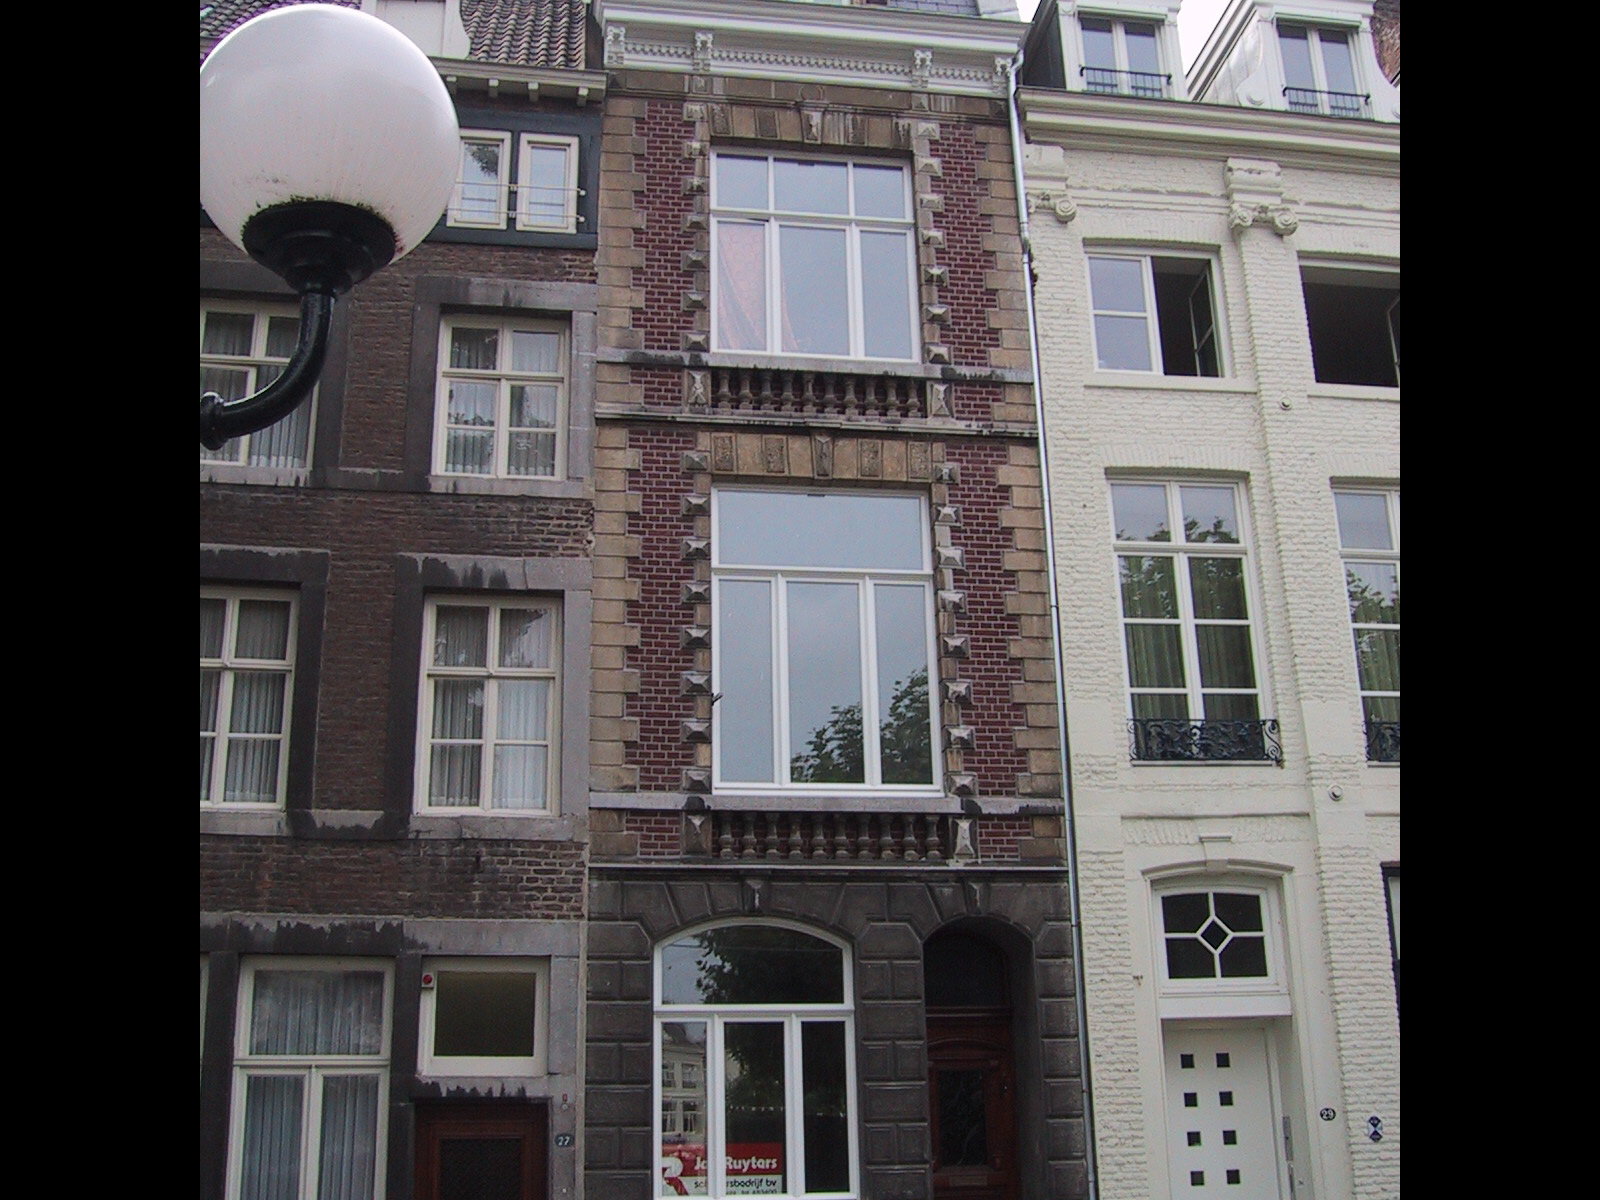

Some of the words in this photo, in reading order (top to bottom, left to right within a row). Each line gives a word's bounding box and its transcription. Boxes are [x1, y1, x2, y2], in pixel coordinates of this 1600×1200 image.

[1321, 1109, 1334, 1119] 29
[558, 1136, 570, 1146] 27
[726, 1156, 777, 1172] Ruytars
[766, 1179, 777, 1187] bv
